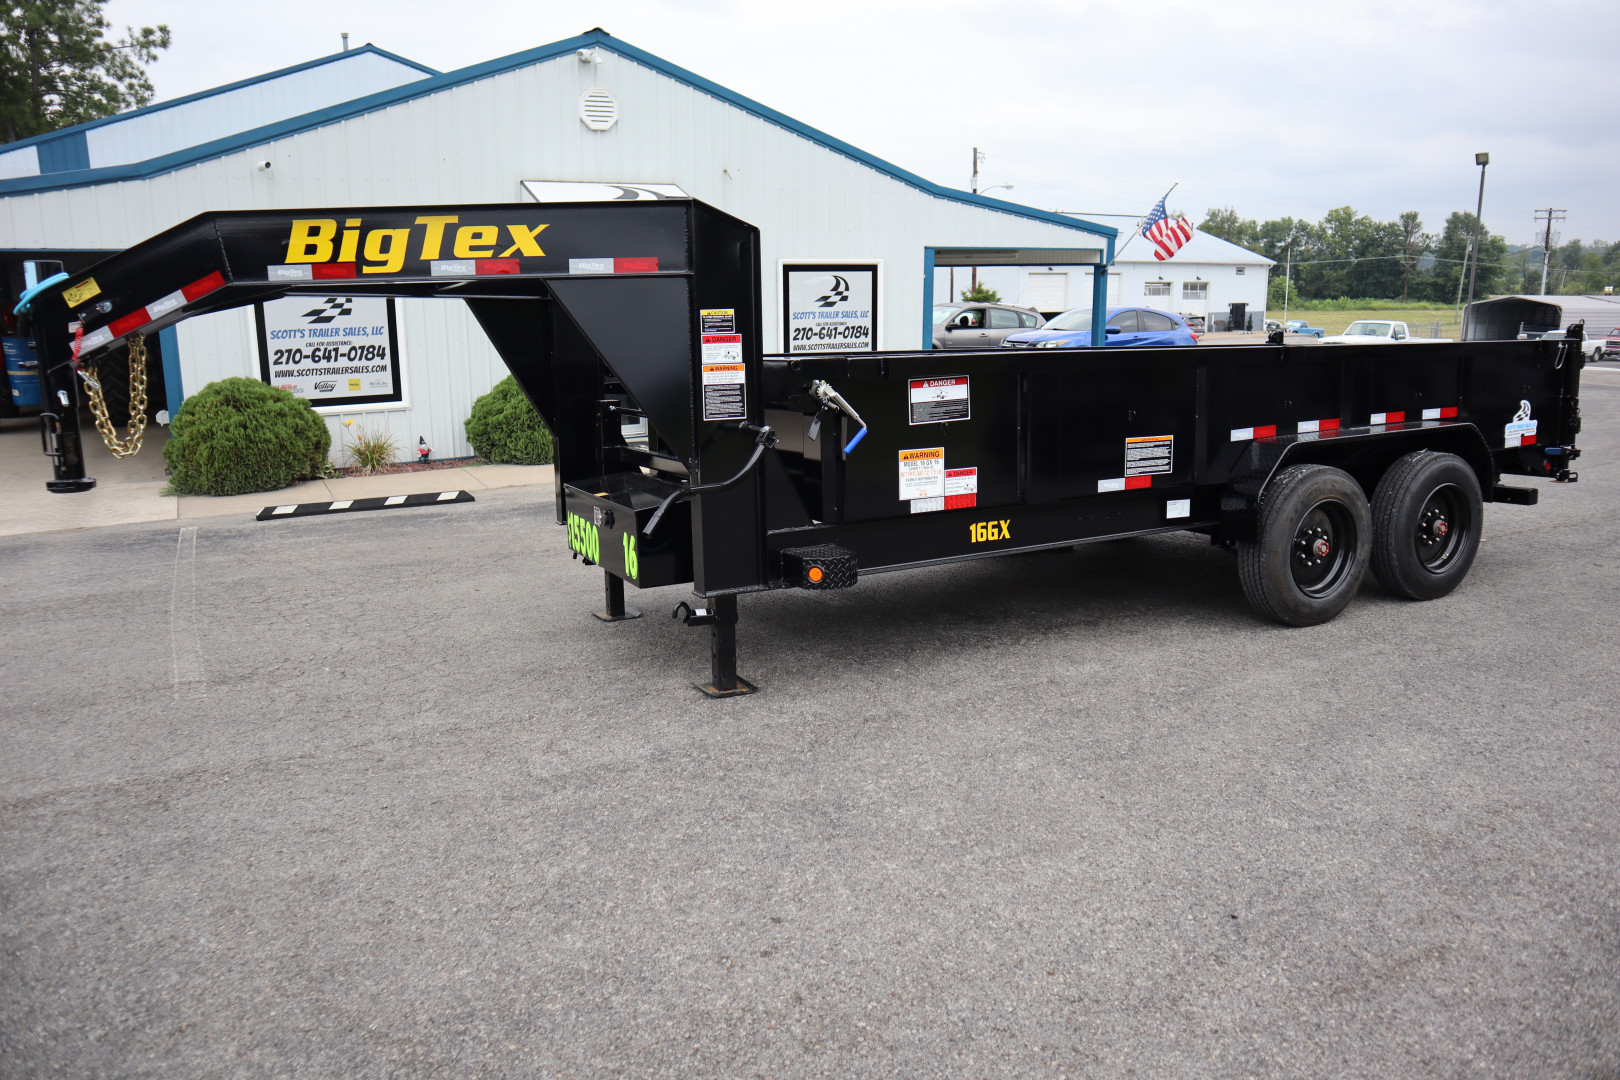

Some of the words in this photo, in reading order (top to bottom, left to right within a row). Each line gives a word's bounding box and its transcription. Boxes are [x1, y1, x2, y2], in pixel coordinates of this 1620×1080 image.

[284, 215, 550, 274] BigTex
[792, 311, 817, 320] SCOTT'S
[818, 311, 840, 319] TRAILER
[841, 310, 859, 319] SALES,
[860, 310, 870, 318] LLC
[270, 328, 306, 340] SCOTT'S
[308, 327, 341, 338] TRAILER
[342, 326, 370, 337] SALES,
[371, 326, 385, 336] LLC
[792, 325, 869, 341] 270-641-0784
[792, 341, 869, 352] WWW.SCOTTSTRAILERSALES.COM
[273, 344, 387, 365] 270-641-0784
[274, 364, 387, 378] WWW.SCOTTSTRAILERSALES.COM
[314, 380, 337, 391] Valley
[930, 379, 956, 387] DANGER
[909, 451, 940, 460] WARNING
[970, 520, 1011, 543] 16GX
[622, 531, 638, 580] 16
